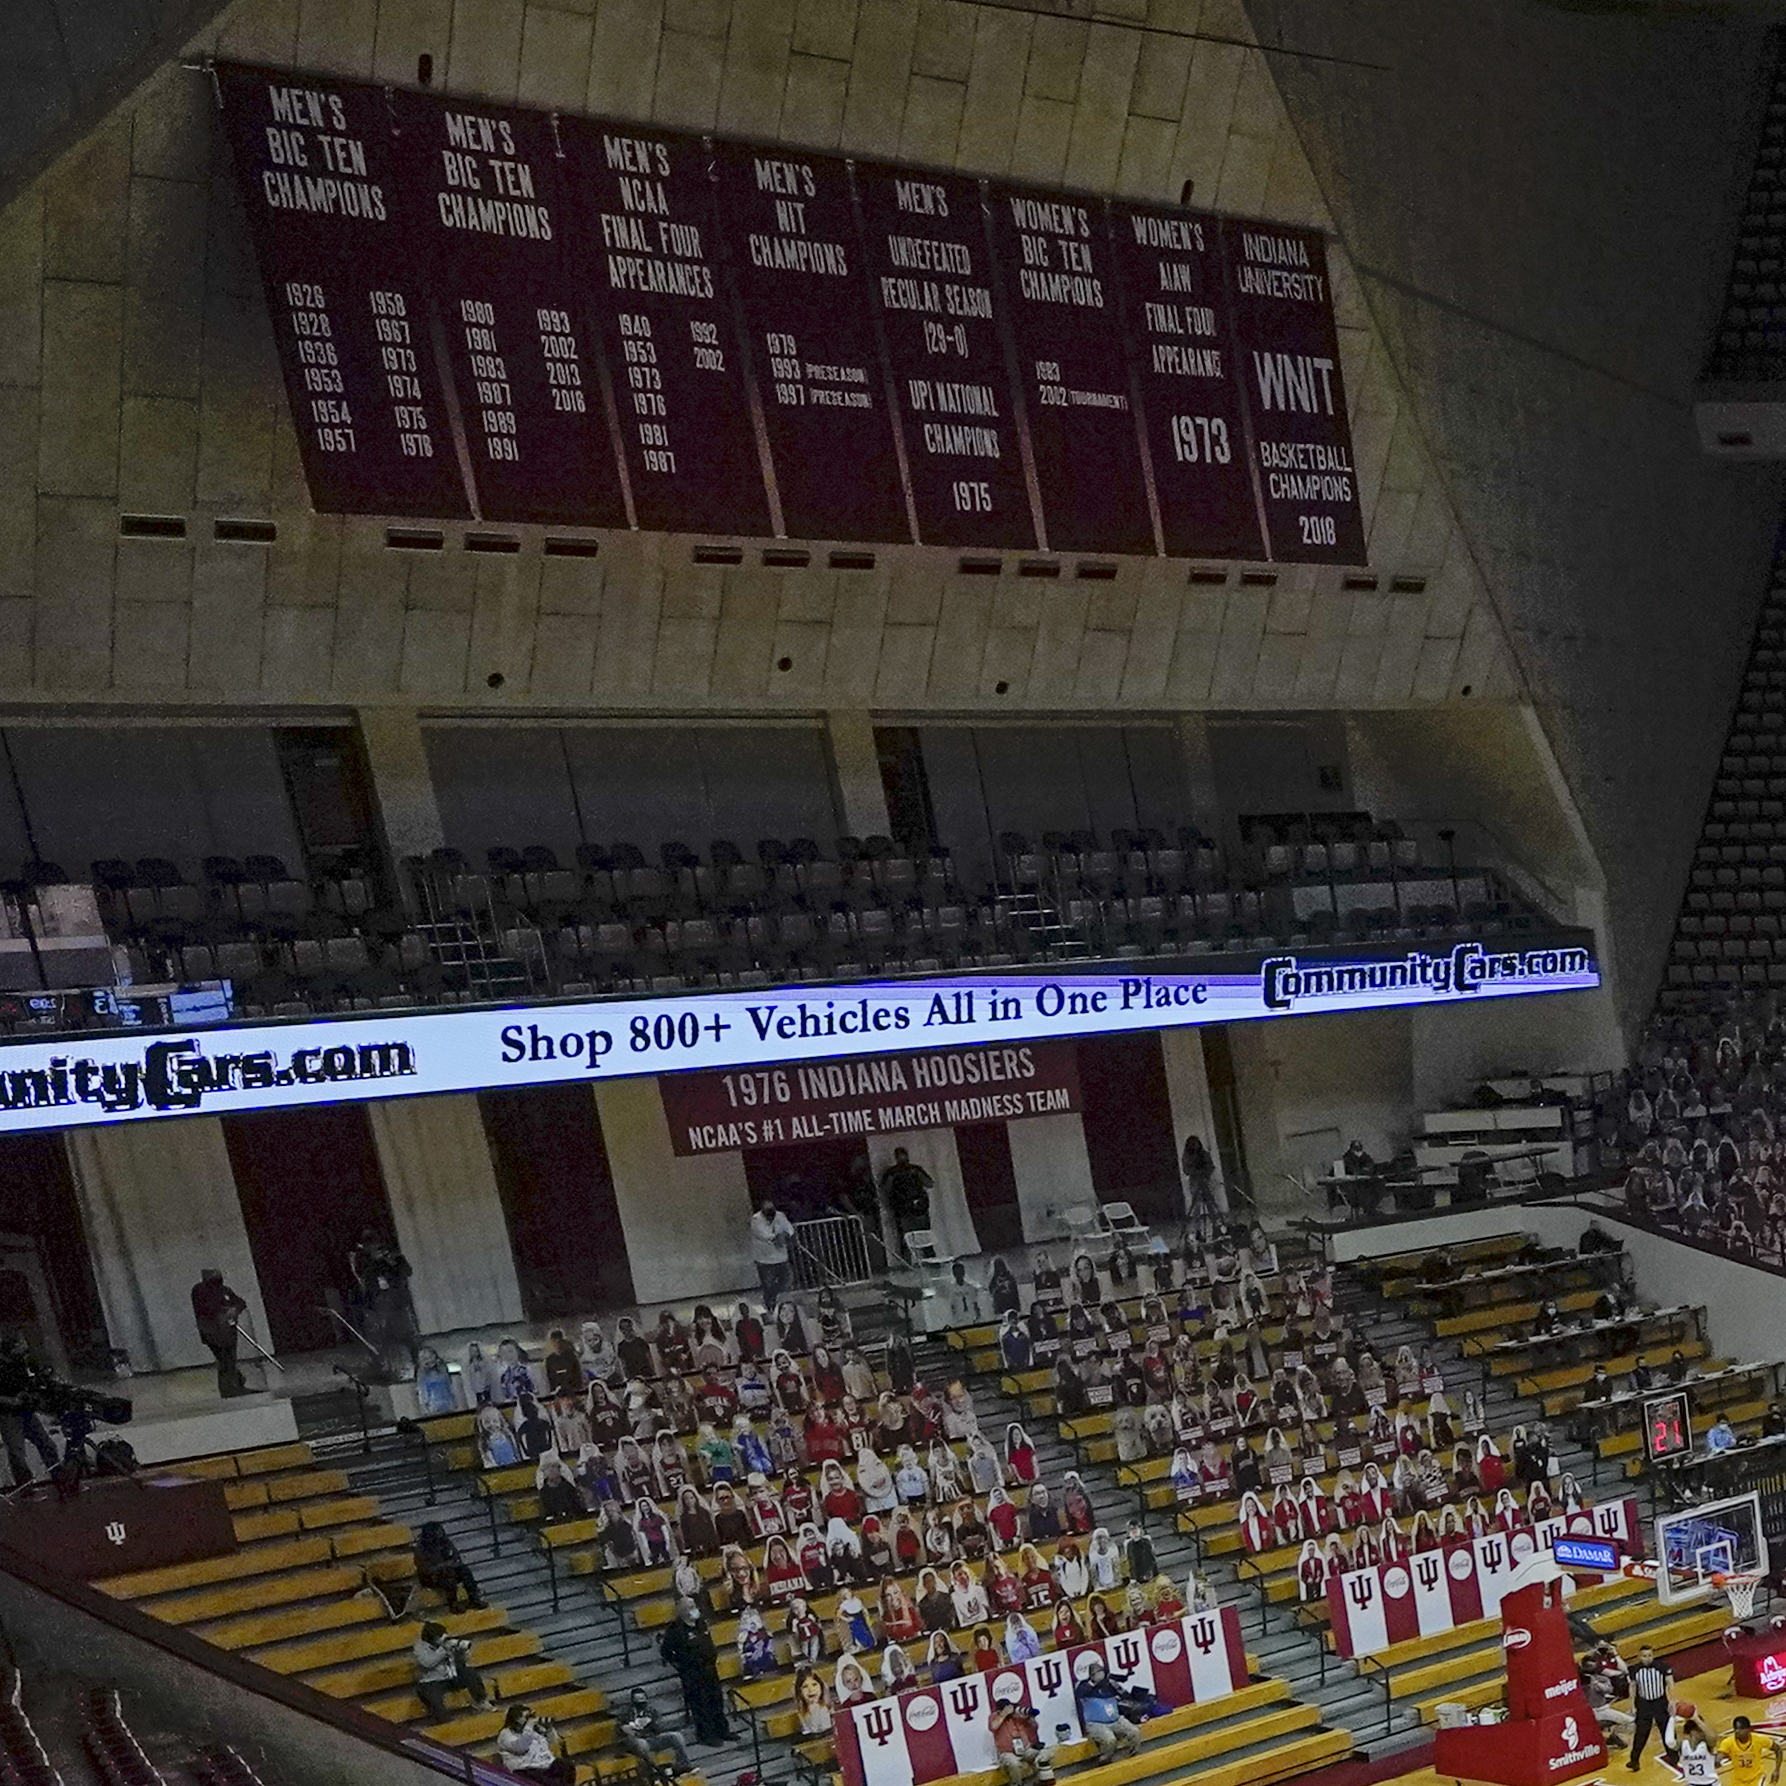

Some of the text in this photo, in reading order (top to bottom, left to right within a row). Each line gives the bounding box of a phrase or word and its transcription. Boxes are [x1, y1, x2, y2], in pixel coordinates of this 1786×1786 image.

[269, 85, 347, 131] MEN'S
[265, 127, 367, 177] BIG TEN
[445, 111, 515, 155] MEN'S
[442, 150, 535, 199] BIG TEN
[603, 135, 671, 177] MEN'S
[262, 170, 387, 221] CHAMPIONS
[619, 177, 670, 216] NCAA
[754, 158, 816, 197] MEN'S
[437, 192, 552, 241] CHAMPIONS
[601, 214, 703, 259] FINAL FOUR
[1010, 197, 1090, 238] WOMEN'S
[1131, 215, 1205, 252] WOMEN'S
[750, 233, 848, 277] CHAMPIONS
[888, 234, 971, 275] UNDEFEATED
[1021, 234, 1093, 274] BIG TEN
[1243, 233, 1310, 268] INDIANA
[608, 254, 714, 299] APPEARANCES
[1020, 268, 1104, 309] CHAMPIONS
[1237, 264, 1323, 302] UNIVERSITY
[1145, 302, 1184, 335] FINAL
[908, 379, 999, 417] UPI NATIONAL
[1253, 350, 1334, 416] WNIT
[923, 423, 1000, 459] CHAMPIONS
[1171, 414, 1231, 464] 1973
[1260, 441, 1352, 473] BASKETBALL
[952, 481, 992, 512] 1975
[1269, 473, 1352, 502] CHAMPIONS
[1300, 516, 1337, 545] 2018
[0, 943, 1589, 1113] nityCars.com Shop 800+ Vehicles All in One Place CommunityCars.com
[722, 1047, 1036, 1108] 1976 INDIANA HOOSIERS
[688, 1088, 1071, 1150] NCAA'S #1 ALL-TIME MARCH MADNESS TEAM
[1653, 1420, 1681, 1452] 21
[1572, 1546, 1615, 1563] DAMAR
[1544, 1678, 1578, 1699] meijer
[1548, 1742, 1601, 1771] Smithville
[1688, 1763, 1705, 1776] 23
[1738, 1757, 1753, 1769] 32
